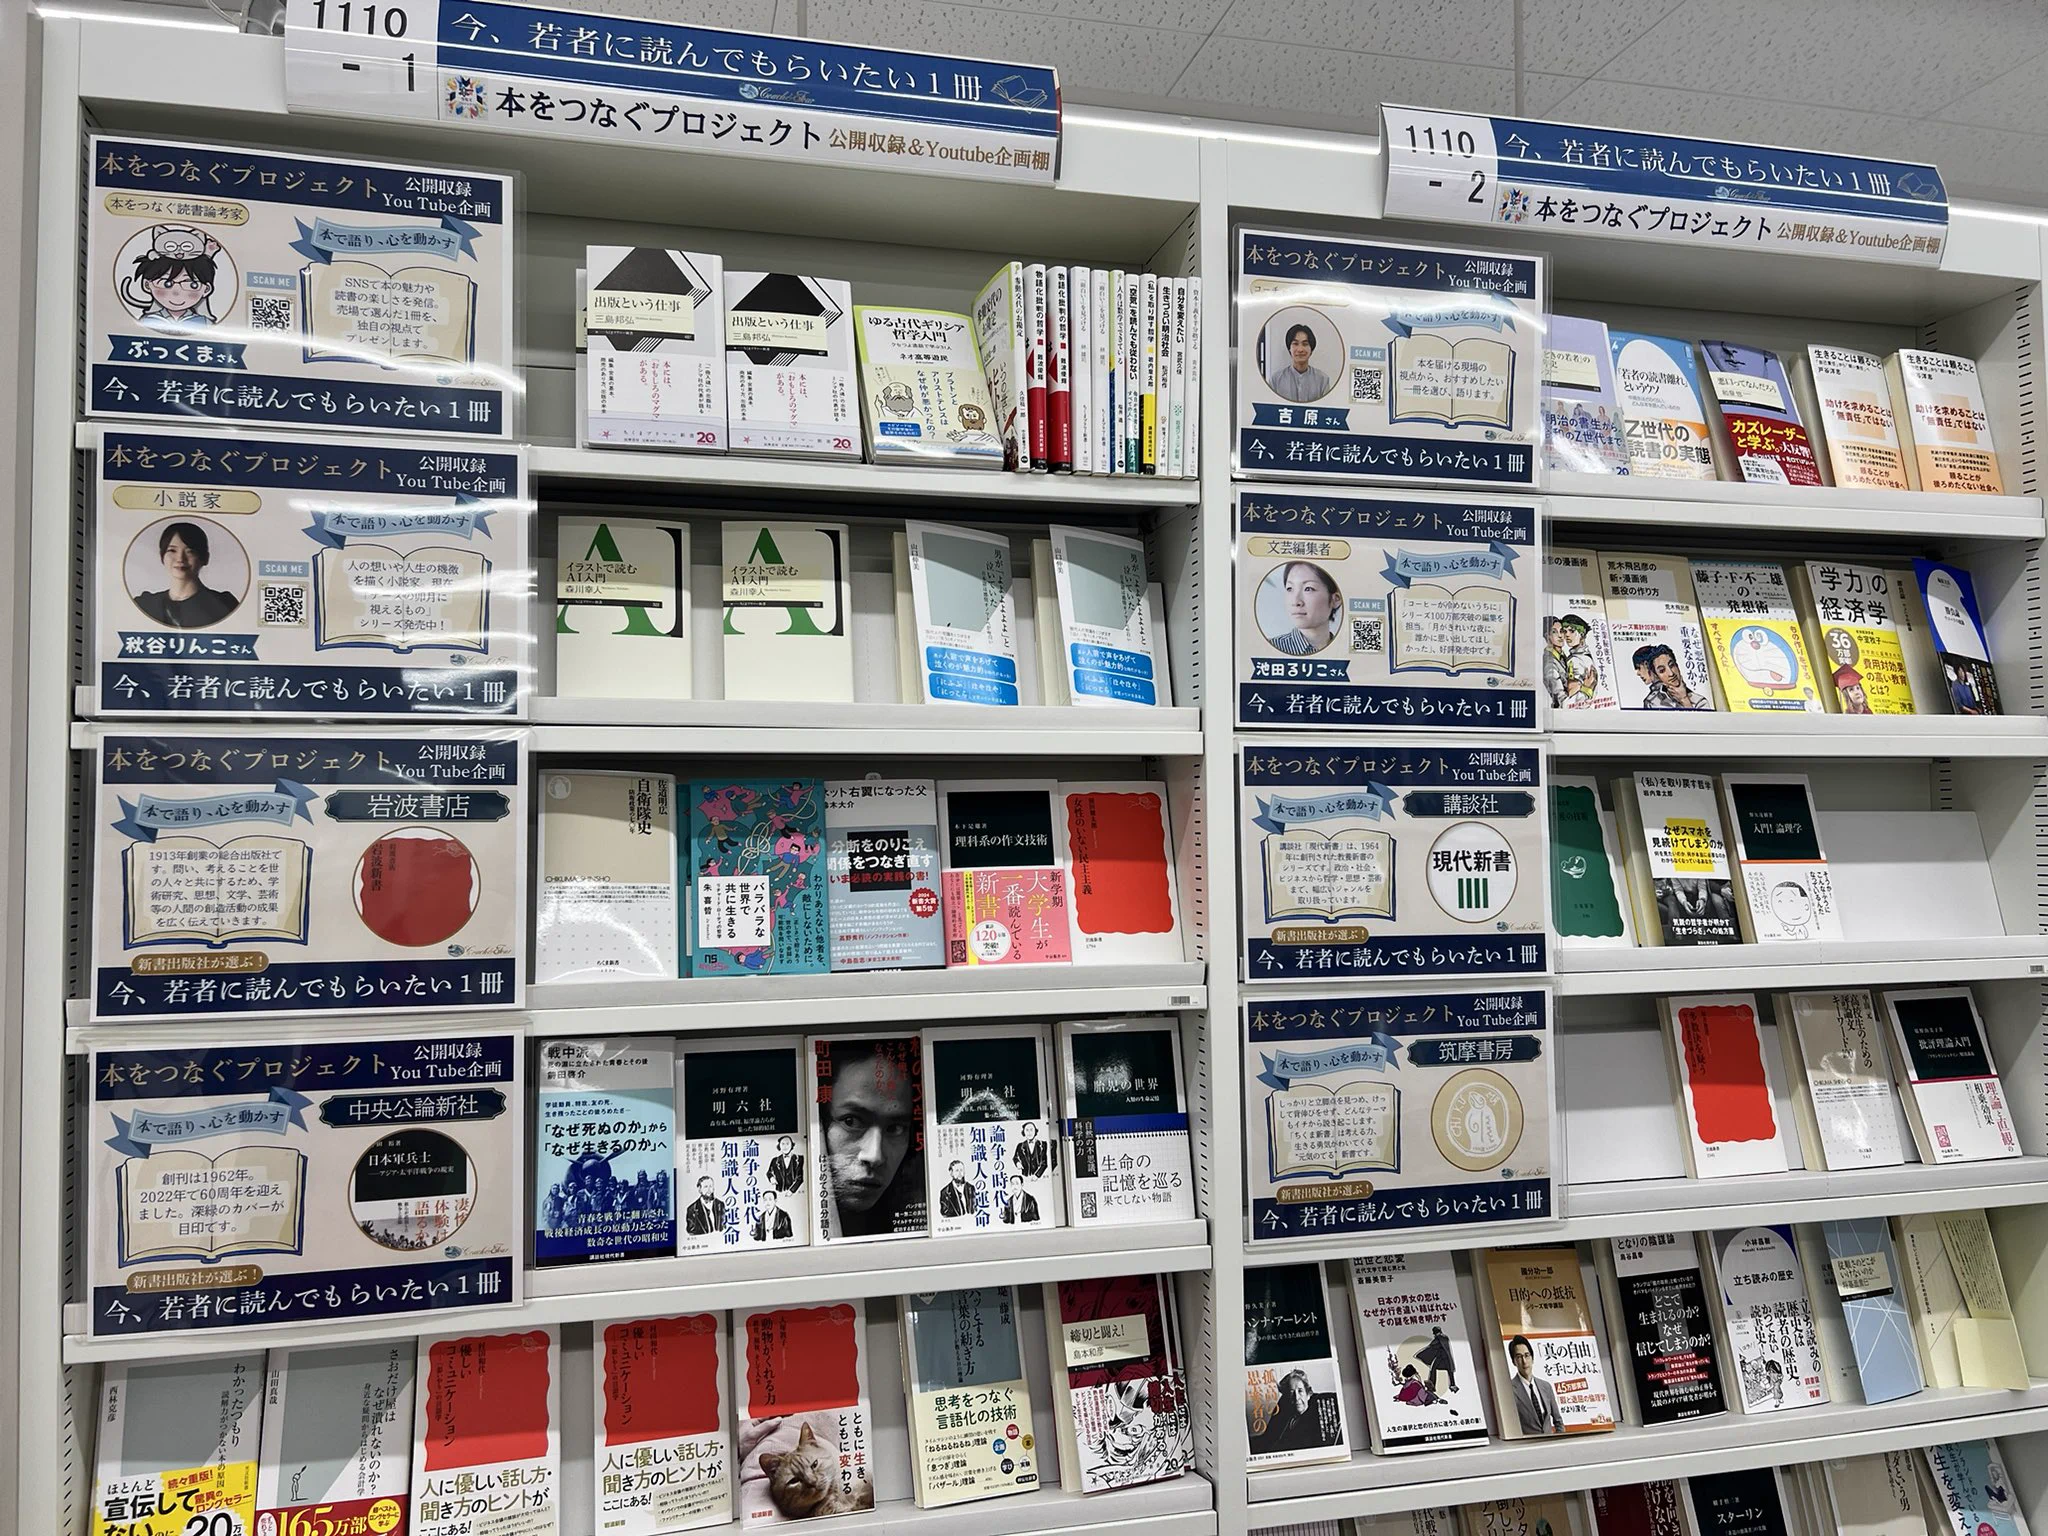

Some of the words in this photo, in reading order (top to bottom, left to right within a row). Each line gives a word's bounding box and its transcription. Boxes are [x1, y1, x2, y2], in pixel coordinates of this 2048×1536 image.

[313, 1, 407, 39] 1110
[402, 53, 414, 92] 1
[496, 86, 821, 150] 本をつなぐプロジェクト
[1406, 125, 1475, 159] 1110
[100, 151, 379, 200] 本をつなぐプロジェクト
[405, 177, 472, 196] 公開収録
[1468, 171, 1484, 204] 2
[110, 197, 244, 221] 本をつなぐ読書論考家
[1535, 196, 1773, 242] 本をつなぐプロジェクト
[1247, 244, 1445, 278] 本をつなぐプロジェクト
[1464, 260, 1513, 276] 公開収録
[254, 275, 272, 285] SCAN
[274, 277, 290, 286] ME
[594, 296, 681, 312] 出版という仕事
[1035, 271, 1044, 336] 物語化批判の哲学
[1058, 273, 1067, 340] 物語化批判の哲学
[595, 314, 634, 325] 三島邦弘
[732, 317, 814, 331] 出版という仕事
[868, 316, 965, 333] ゆる古代ギリシア
[1161, 287, 1170, 358] 生きづらい明治社会
[1177, 287, 1185, 344] 自分を変えたい
[357, 320, 423, 335] 独自の視点で
[894, 329, 947, 342] 哲学入門
[1417, 359, 1487, 372] 本を届ける現場の
[1814, 349, 1882, 370] 生きることは頼ること
[1624, 382, 1660, 395] というウソ
[1825, 399, 1892, 419] 助けを求めることは
[696, 432, 715, 443] 20
[1625, 420, 1689, 442] Z世代の
[1732, 420, 1806, 441] カズレーザー
[833, 438, 850, 449] 20
[107, 444, 392, 479] 本をつなぐプロジェクト
[419, 456, 487, 473] 公開収録
[1933, 480, 1999, 493] 後ろめたくない社会へ
[153, 491, 222, 509] 小説家
[1243, 504, 1444, 530] 本をつなぐプロジェクト
[1462, 509, 1512, 523] 公開収録
[1446, 524, 1468, 538] You
[1472, 525, 1526, 540] Tube企画
[1268, 541, 1331, 556] 文芸編集者
[265, 563, 286, 574] SCAN
[288, 563, 303, 575] ME
[347, 560, 459, 577] 人の想いや人生の機微
[567, 563, 637, 574] イラストで読む
[731, 566, 798, 576] イラストで読む
[1607, 561, 1657, 572] 荒木飛呂彦の
[1809, 564, 1888, 595] 「学力」の
[565, 585, 602, 594] 森川幸人
[730, 588, 765, 596] 森川幸人
[1611, 586, 1659, 597] 悪役の作り方
[1738, 586, 1749, 597] の
[1727, 600, 1769, 614] 発想術
[1820, 595, 1888, 625] 経済学
[125, 637, 252, 656] 秋谷りんこさん
[1831, 632, 1851, 649] 36
[1256, 662, 1346, 677] 池田るりこさん
[1863, 659, 1905, 673] 費用対効果
[1866, 673, 1907, 686] の高い教育
[418, 745, 486, 760] 公開収録
[1468, 752, 1517, 765] 公開収録
[395, 764, 426, 779] You
[431, 763, 505, 780] Tube企画
[1247, 756, 1449, 775] 本をつなぐプロジェクト
[1452, 768, 1474, 781] You
[1479, 768, 1531, 782] Tube企画
[368, 795, 470, 818] 岩波書店
[636, 778, 652, 836] 自衛隊史
[1444, 795, 1499, 814] 講談社
[1664, 825, 1712, 836] なぜスマホを
[831, 837, 927, 854] 分断をのりこえ
[955, 834, 1047, 848] 理科系の作文技術
[1652, 838, 1724, 849] 見続けてしまうのか
[370, 844, 382, 892] 岩波新書
[1432, 850, 1511, 873] 現代新書
[976, 872, 999, 918] 新書
[1050, 871, 1064, 908] 新学期
[739, 883, 751, 915] 世界で
[725, 883, 737, 939] 共に生きる
[754, 882, 765, 937] バラバラな
[1026, 871, 1053, 950] 大学生が
[813, 874, 826, 967] わかりあえない他者を、
[1474, 997, 1523, 1010] 公開収録
[1252, 1004, 1453, 1030] 本をつなぐプロジェクト
[1458, 1015, 1480, 1027] You
[1484, 1011, 1538, 1026] Tube企画
[414, 1043, 483, 1061] 公開収録
[1439, 1040, 1513, 1061] 筑摩書房
[1919, 1037, 1971, 1050] 批評理論入門
[1093, 1078, 1159, 1093] 胎児の世界
[349, 1095, 479, 1121] 中央公論新社
[544, 1121, 668, 1138] 「なぜ死ぬのか」から
[544, 1138, 668, 1156] 「なぜ生きるのか」へ
[368, 1151, 432, 1166] 日本軍兵士
[1101, 1153, 1151, 1172] 生命の
[162, 1168, 255, 1185] 創刊は1962年。
[1102, 1172, 1182, 1193] 記憶を巡る
[721, 1141, 740, 1245] 知識人の運命
[743, 1139, 761, 1237] 論争の時代と
[1103, 1192, 1172, 1206] 果てしない物語
[139, 1199, 284, 1220] ました。深緑のカバーが
[179, 1220, 239, 1237] 目印です。
[1734, 1270, 1794, 1286] 立ち読みの歴史
[1377, 1293, 1440, 1306] 日本の男女の恋は
[1509, 1287, 1576, 1302] 目的への抵抗
[1654, 1294, 1680, 1308] どこで
[1378, 1314, 1447, 1327] その謎を解き明かす
[1663, 1322, 1682, 1336] なぜ
[1789, 1301, 1804, 1347] 歴史は
[633, 1327, 645, 1361] 優しい
[1636, 1333, 1711, 1356] 信じてしまうのか?
[460, 1344, 473, 1379] 優しい
[761, 1318, 776, 1406] 動物がくれる力
[1073, 1347, 1105, 1361] 島本和彦
[619, 1328, 632, 1425] コミュニケーション
[1544, 1362, 1601, 1377] を手に入れよ。
[231, 1363, 245, 1447] わかったつもり
[444, 1346, 456, 1447] コミュニケーション
[935, 1387, 1014, 1411] 思考をつなぐ
[936, 1404, 1017, 1430] 言語化の技術
[369, 1387, 385, 1496] なぜ潰れないのか?
[853, 1412, 868, 1484] ともに生き、
[839, 1415, 852, 1495] ともに変わる
[108, 1479, 154, 1494] ほとんど
[603, 1460, 722, 1495] 聞き方のヒントが
[103, 1488, 200, 1522] 宣伝して
[194, 1490, 223, 1504] 驚異の
[196, 1494, 252, 1513] ロングセラー
[420, 1487, 549, 1523] 聞き方のヒントが
[603, 1493, 652, 1511] ここにある!
[1717, 1508, 1764, 1524] スターリン
